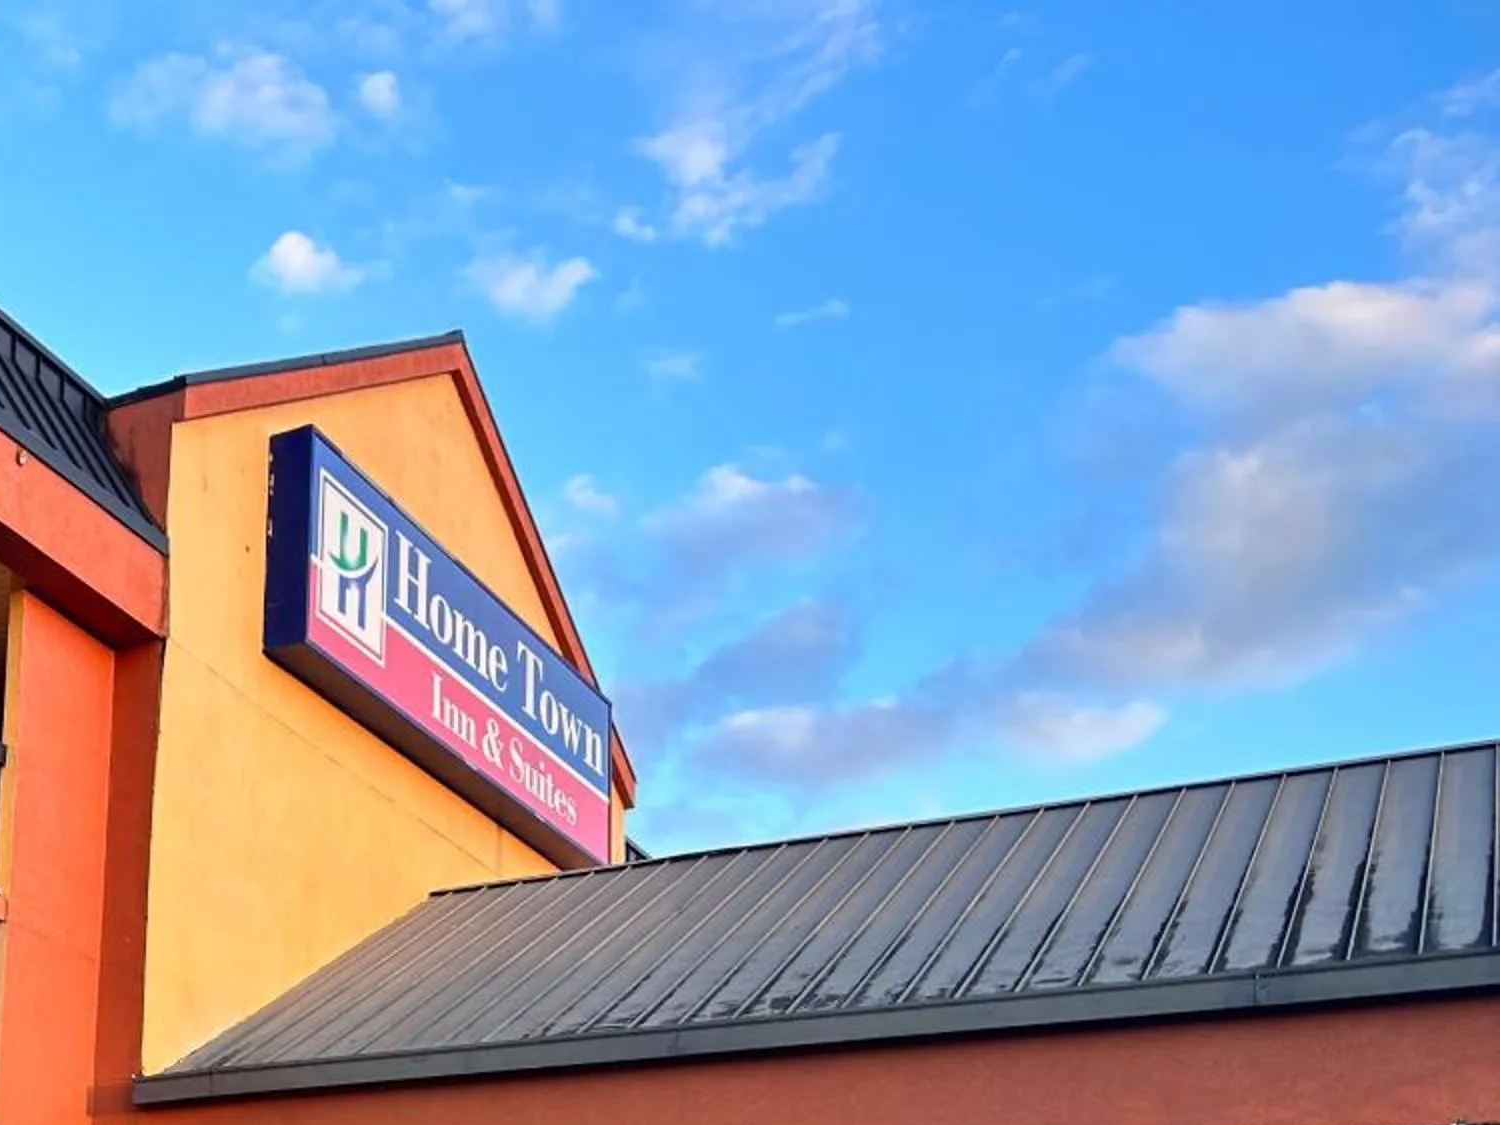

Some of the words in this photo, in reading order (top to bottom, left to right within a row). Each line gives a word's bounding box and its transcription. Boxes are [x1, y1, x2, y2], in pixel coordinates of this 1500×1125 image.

[394, 529, 508, 693] Home
[517, 640, 604, 777] Town
[430, 671, 477, 750] Inn
[482, 716, 505, 770] &
[508, 736, 578, 827] Suites
